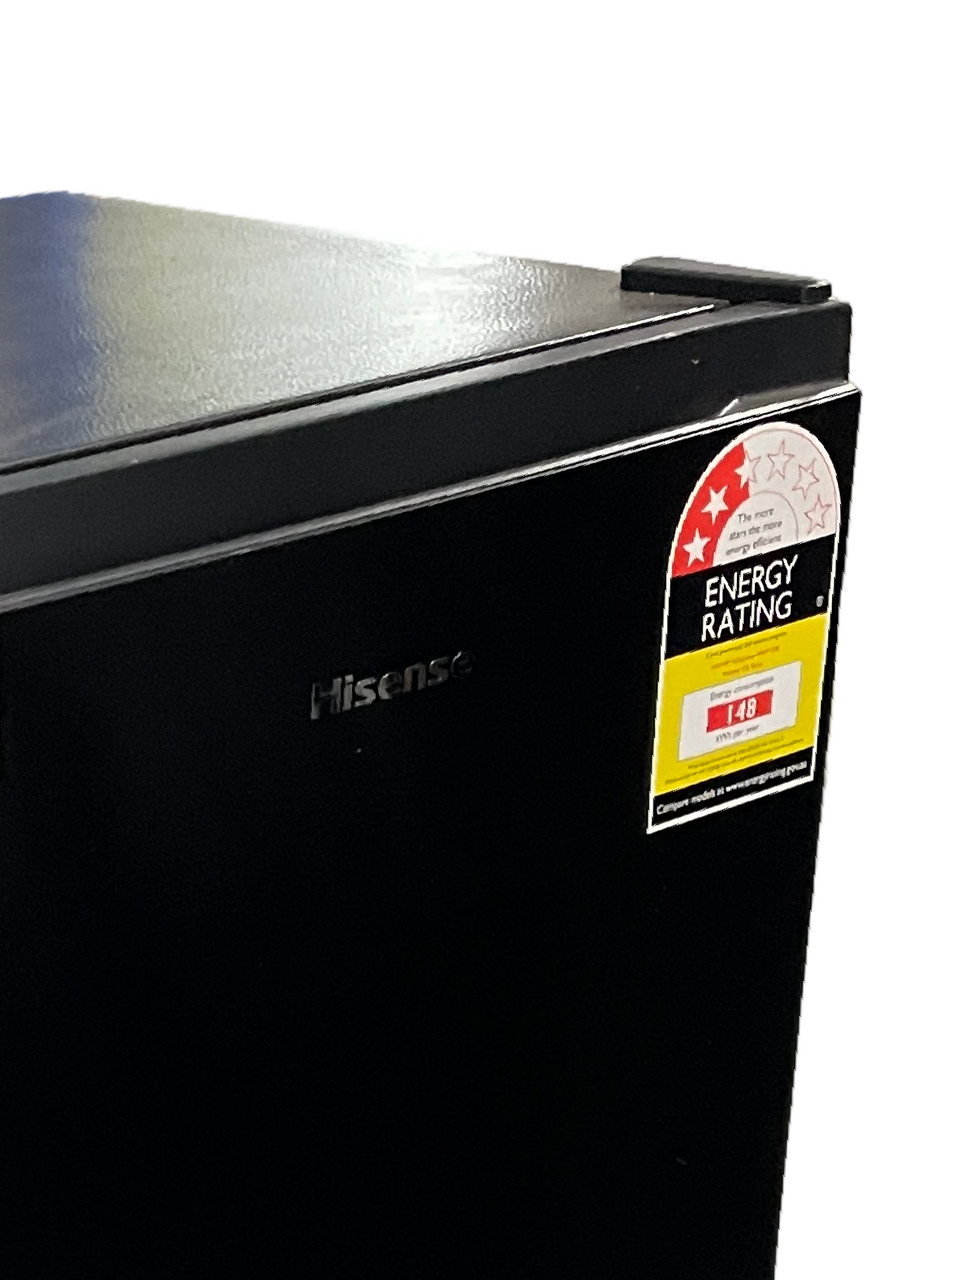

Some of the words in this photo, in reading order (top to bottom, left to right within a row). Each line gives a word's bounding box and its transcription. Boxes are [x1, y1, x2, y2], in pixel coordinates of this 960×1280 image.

[737, 513, 752, 523] The
[754, 508, 774, 519] more
[705, 554, 799, 608] ENERGY
[701, 591, 792, 642] RATING
[310, 651, 476, 720] Hisense
[710, 690, 732, 701] Energy
[727, 697, 757, 725] 148
[656, 799, 689, 816] Compare
